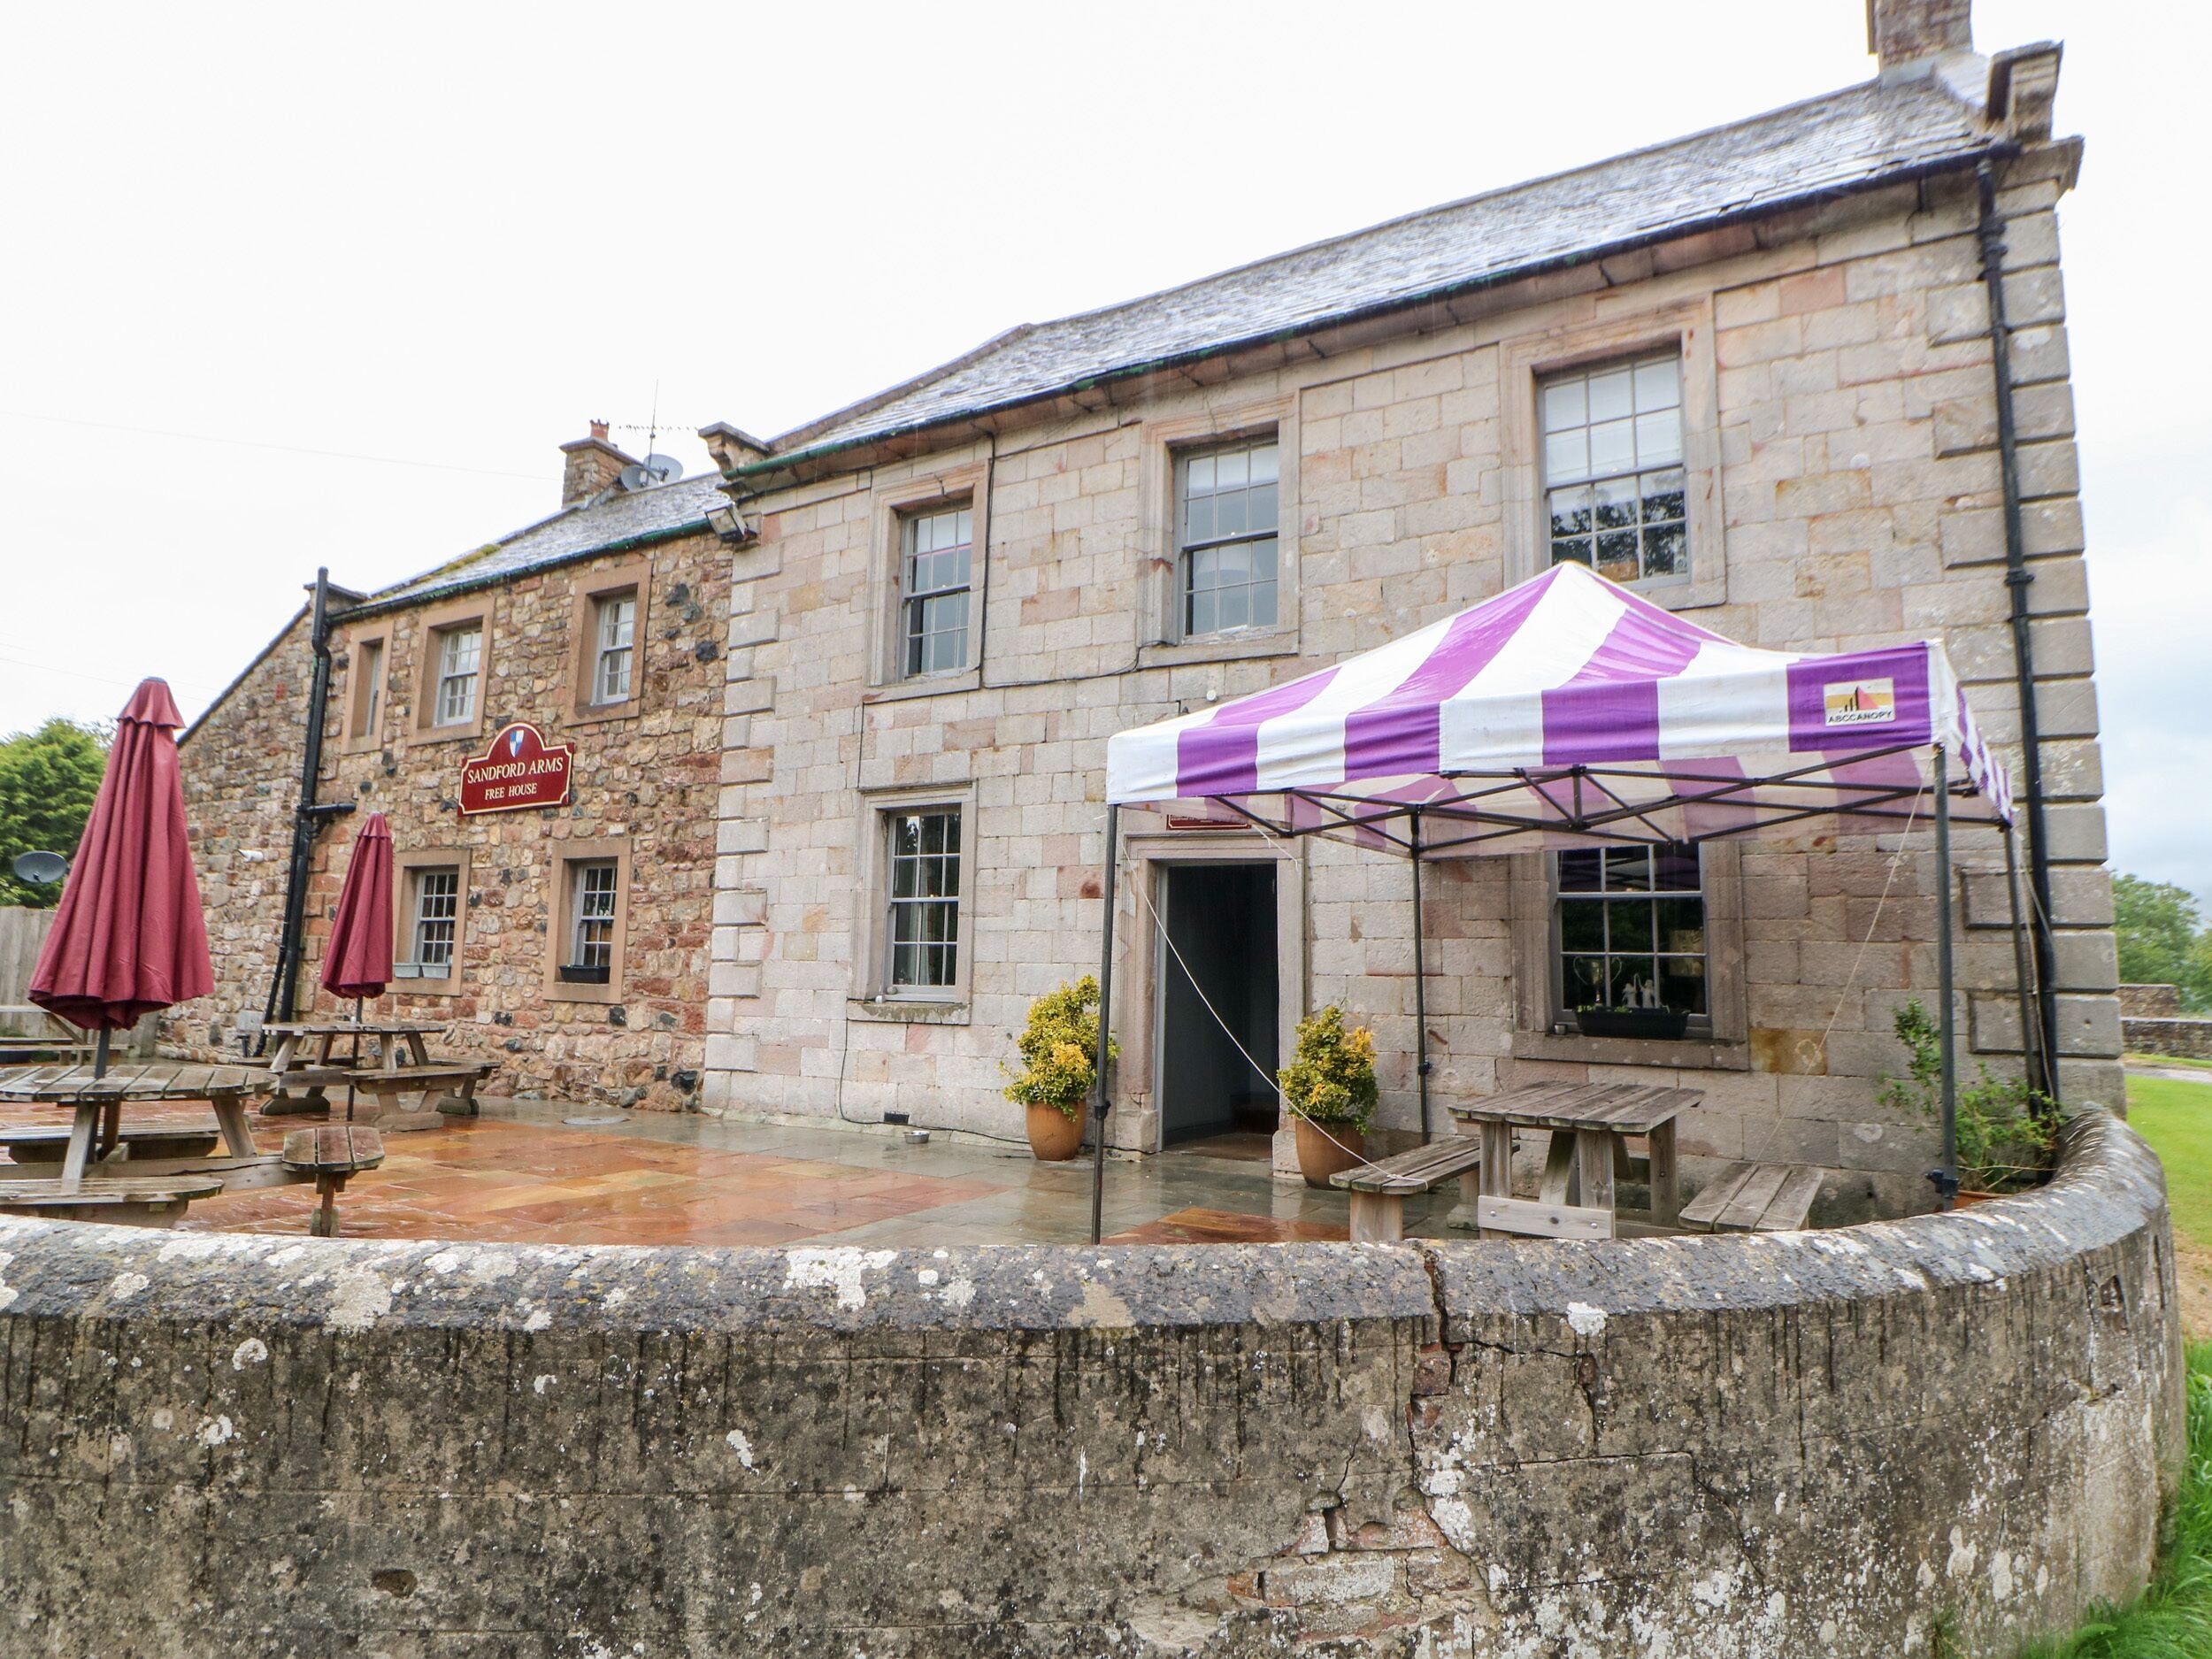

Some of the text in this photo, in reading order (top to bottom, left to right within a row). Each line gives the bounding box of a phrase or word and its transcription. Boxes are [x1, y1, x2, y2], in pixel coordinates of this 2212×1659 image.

[1828, 710, 1892, 723] ABCCANOPY
[467, 757, 564, 784] SANDFORD ARMS
[485, 783, 537, 801] FREE HOUSE
